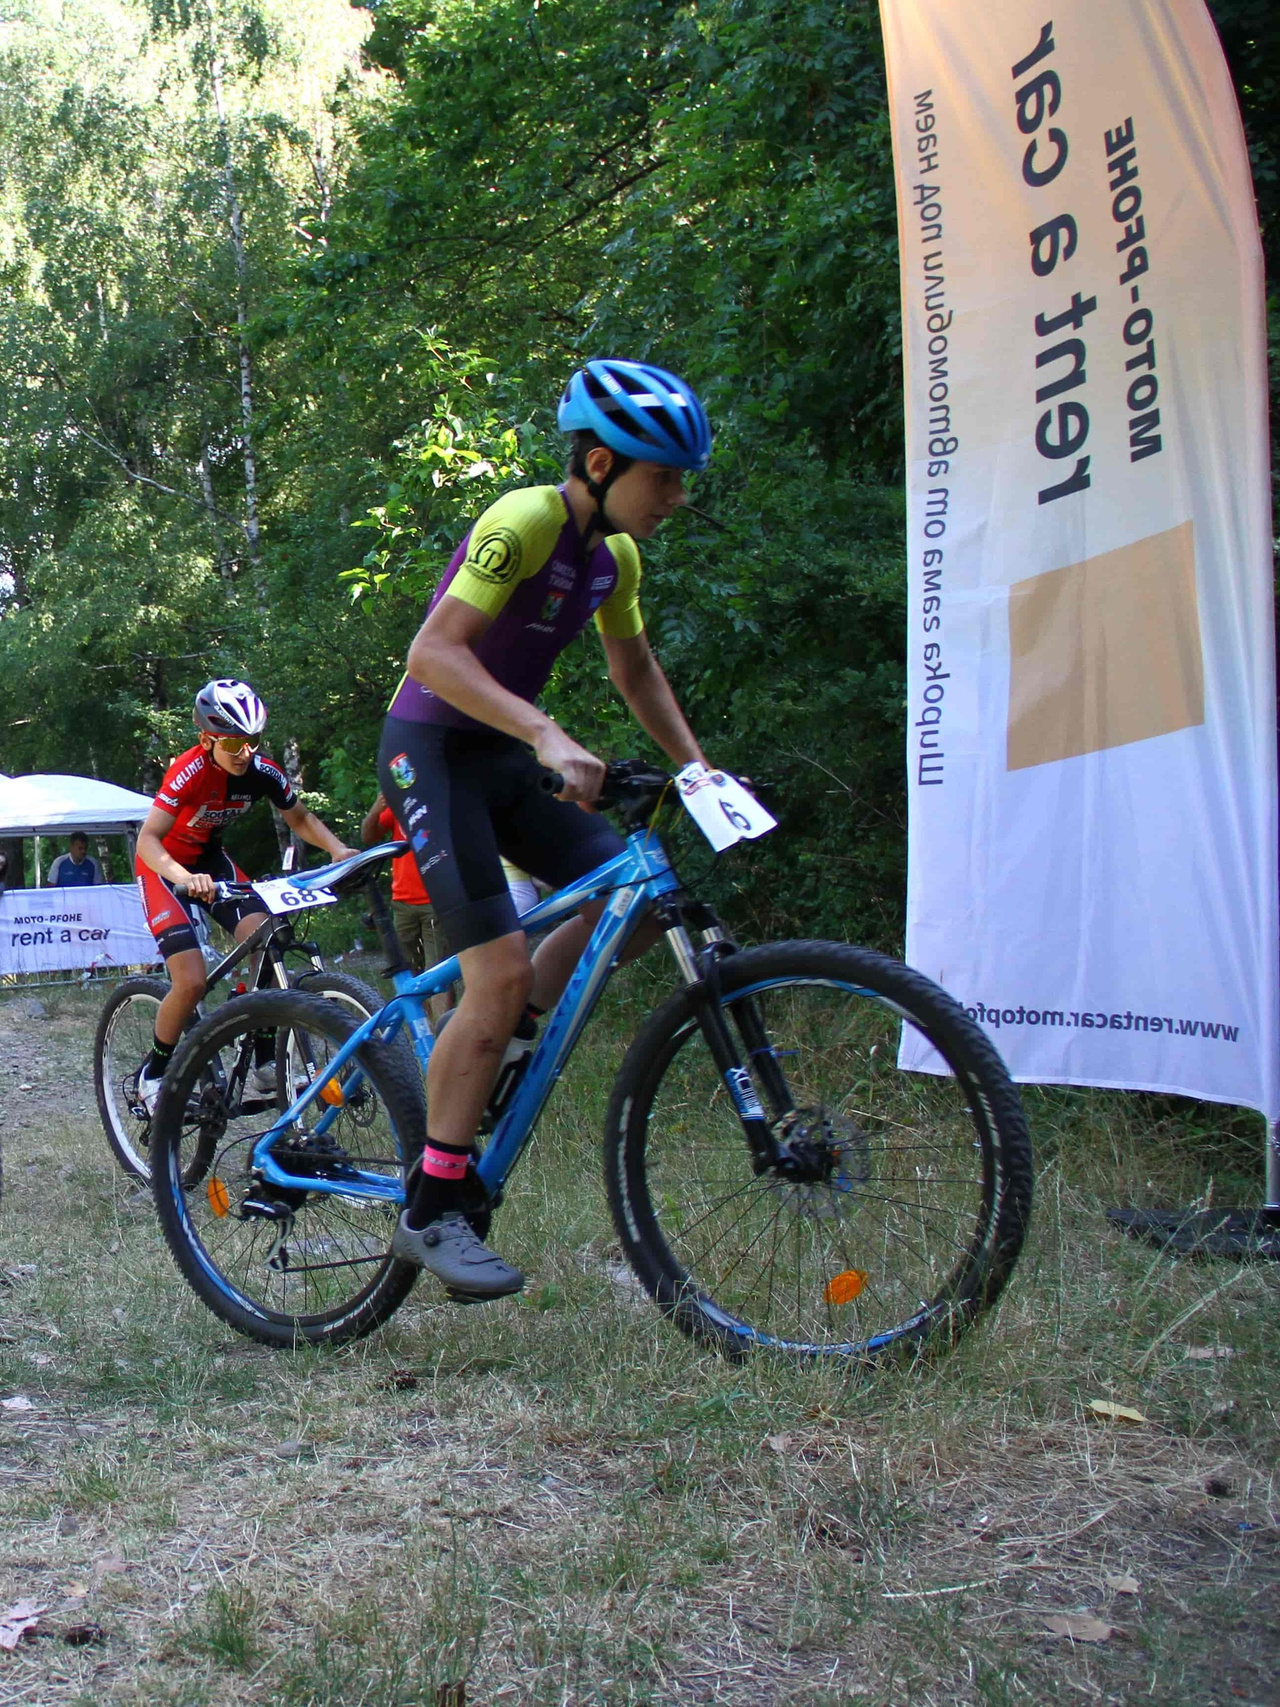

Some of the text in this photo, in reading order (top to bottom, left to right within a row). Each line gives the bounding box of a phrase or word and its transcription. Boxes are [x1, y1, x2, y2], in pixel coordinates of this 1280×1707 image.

[14, 913, 83, 925] MOTO-PFOHE
[11, 927, 111, 947] rent a car
